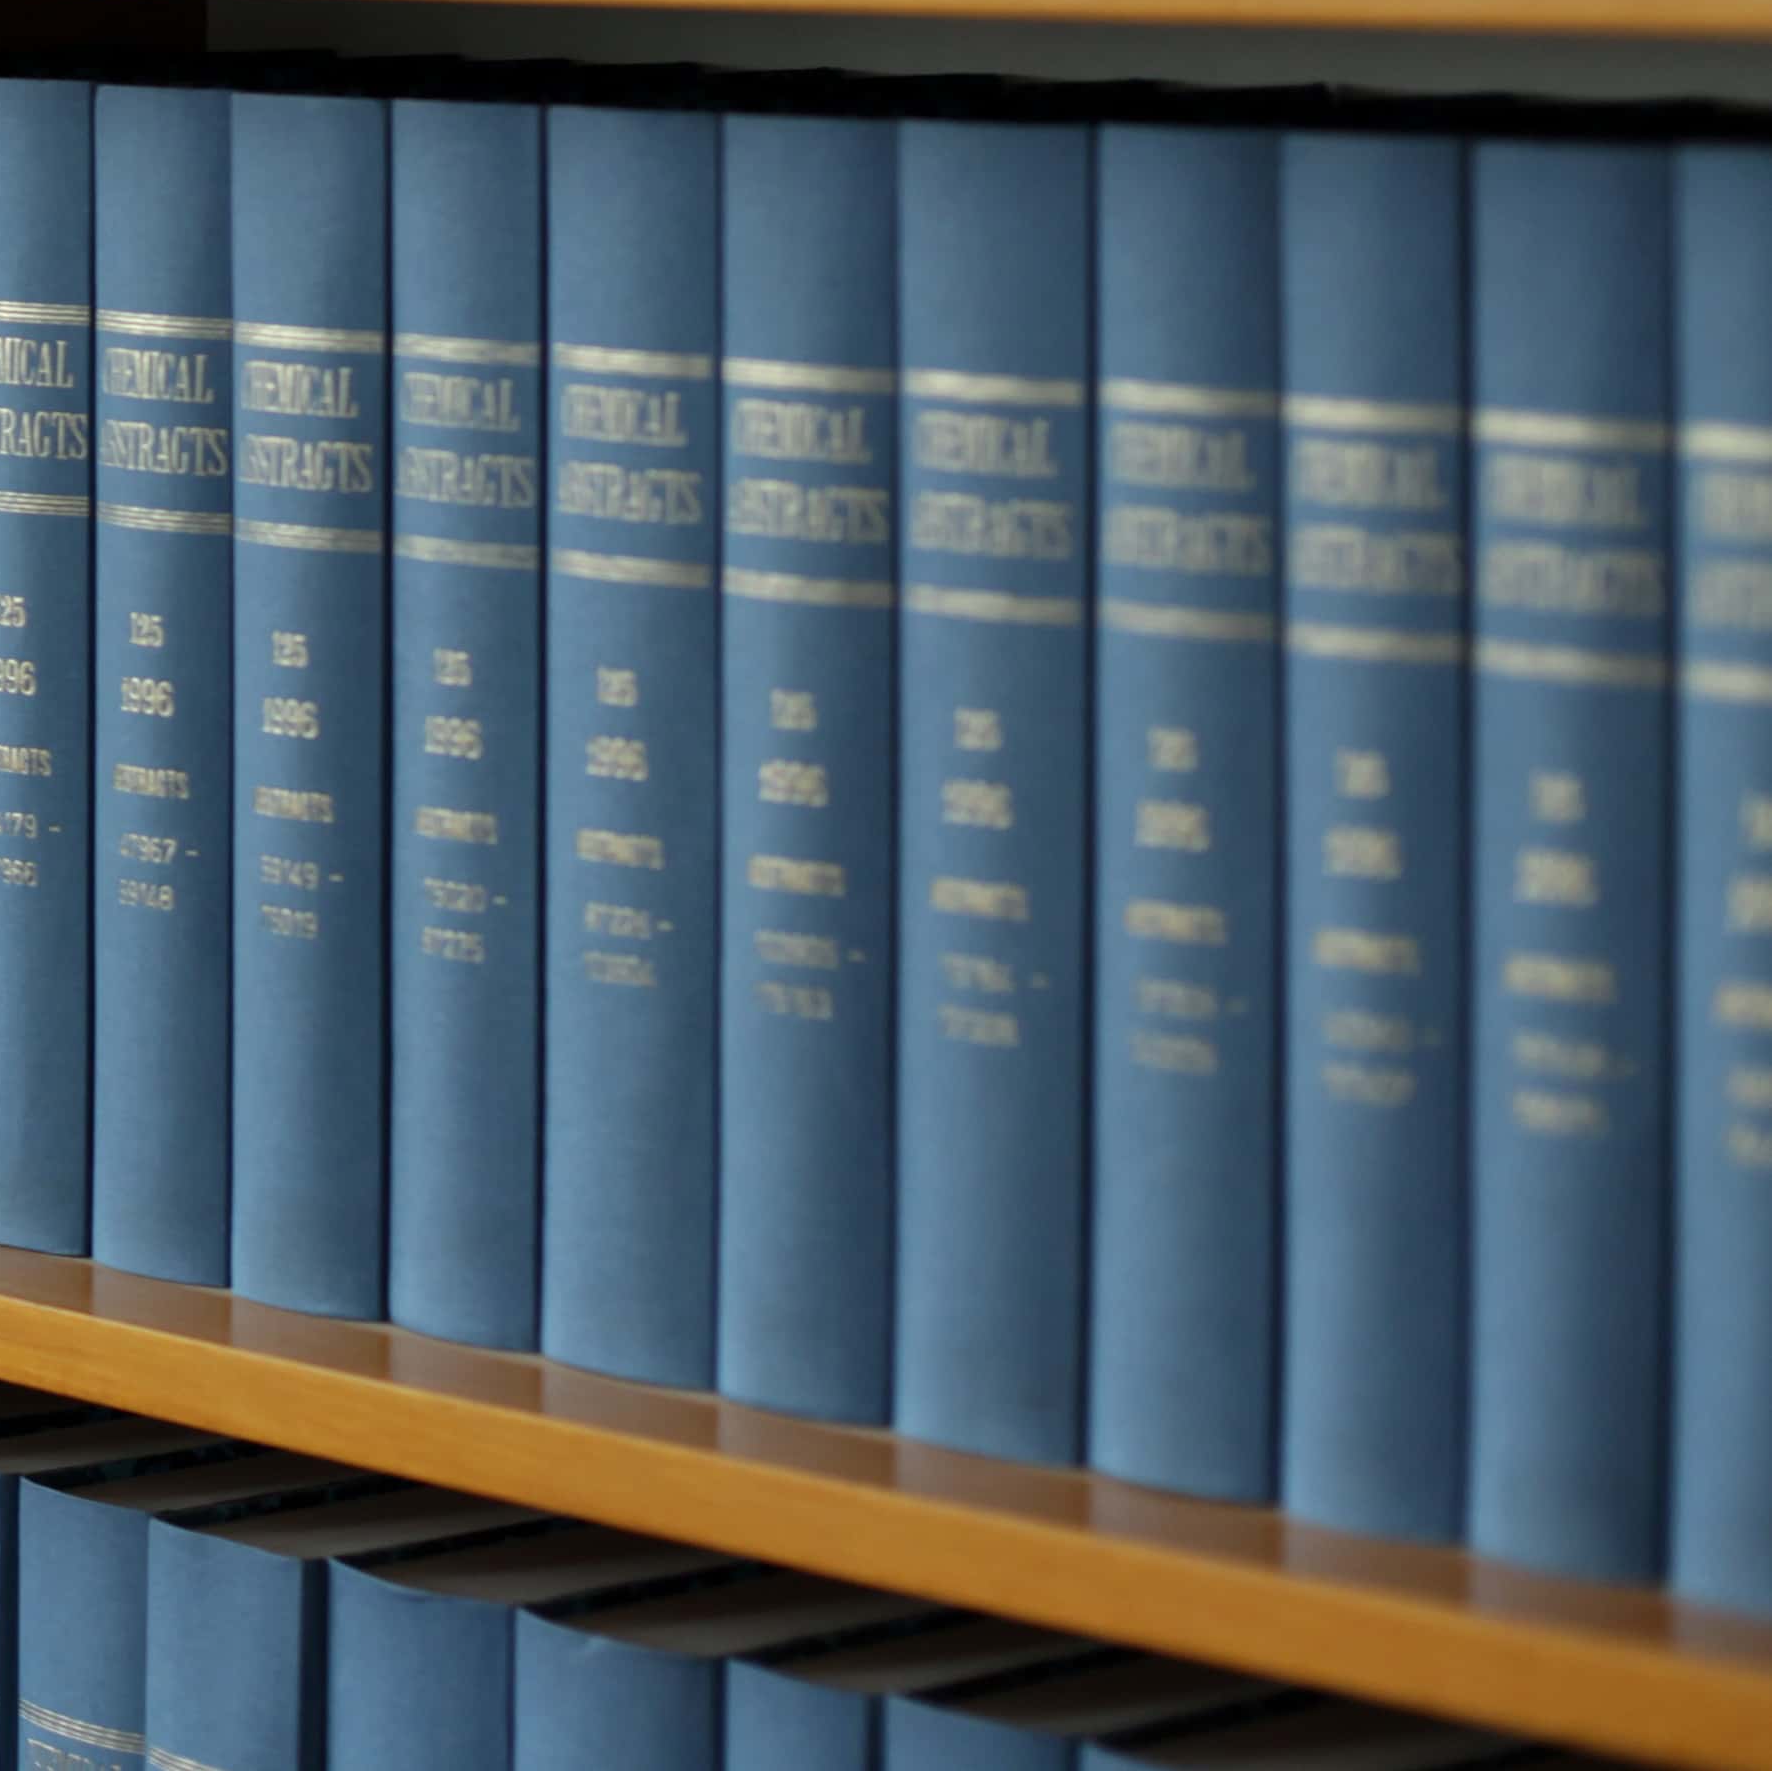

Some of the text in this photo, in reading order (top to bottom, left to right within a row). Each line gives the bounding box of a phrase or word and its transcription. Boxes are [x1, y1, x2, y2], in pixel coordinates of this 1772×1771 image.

[103, 346, 214, 404] CHEMICAL
[101, 419, 229, 478] ABSTRACTS
[129, 611, 165, 649] 125
[120, 675, 175, 718] 1996
